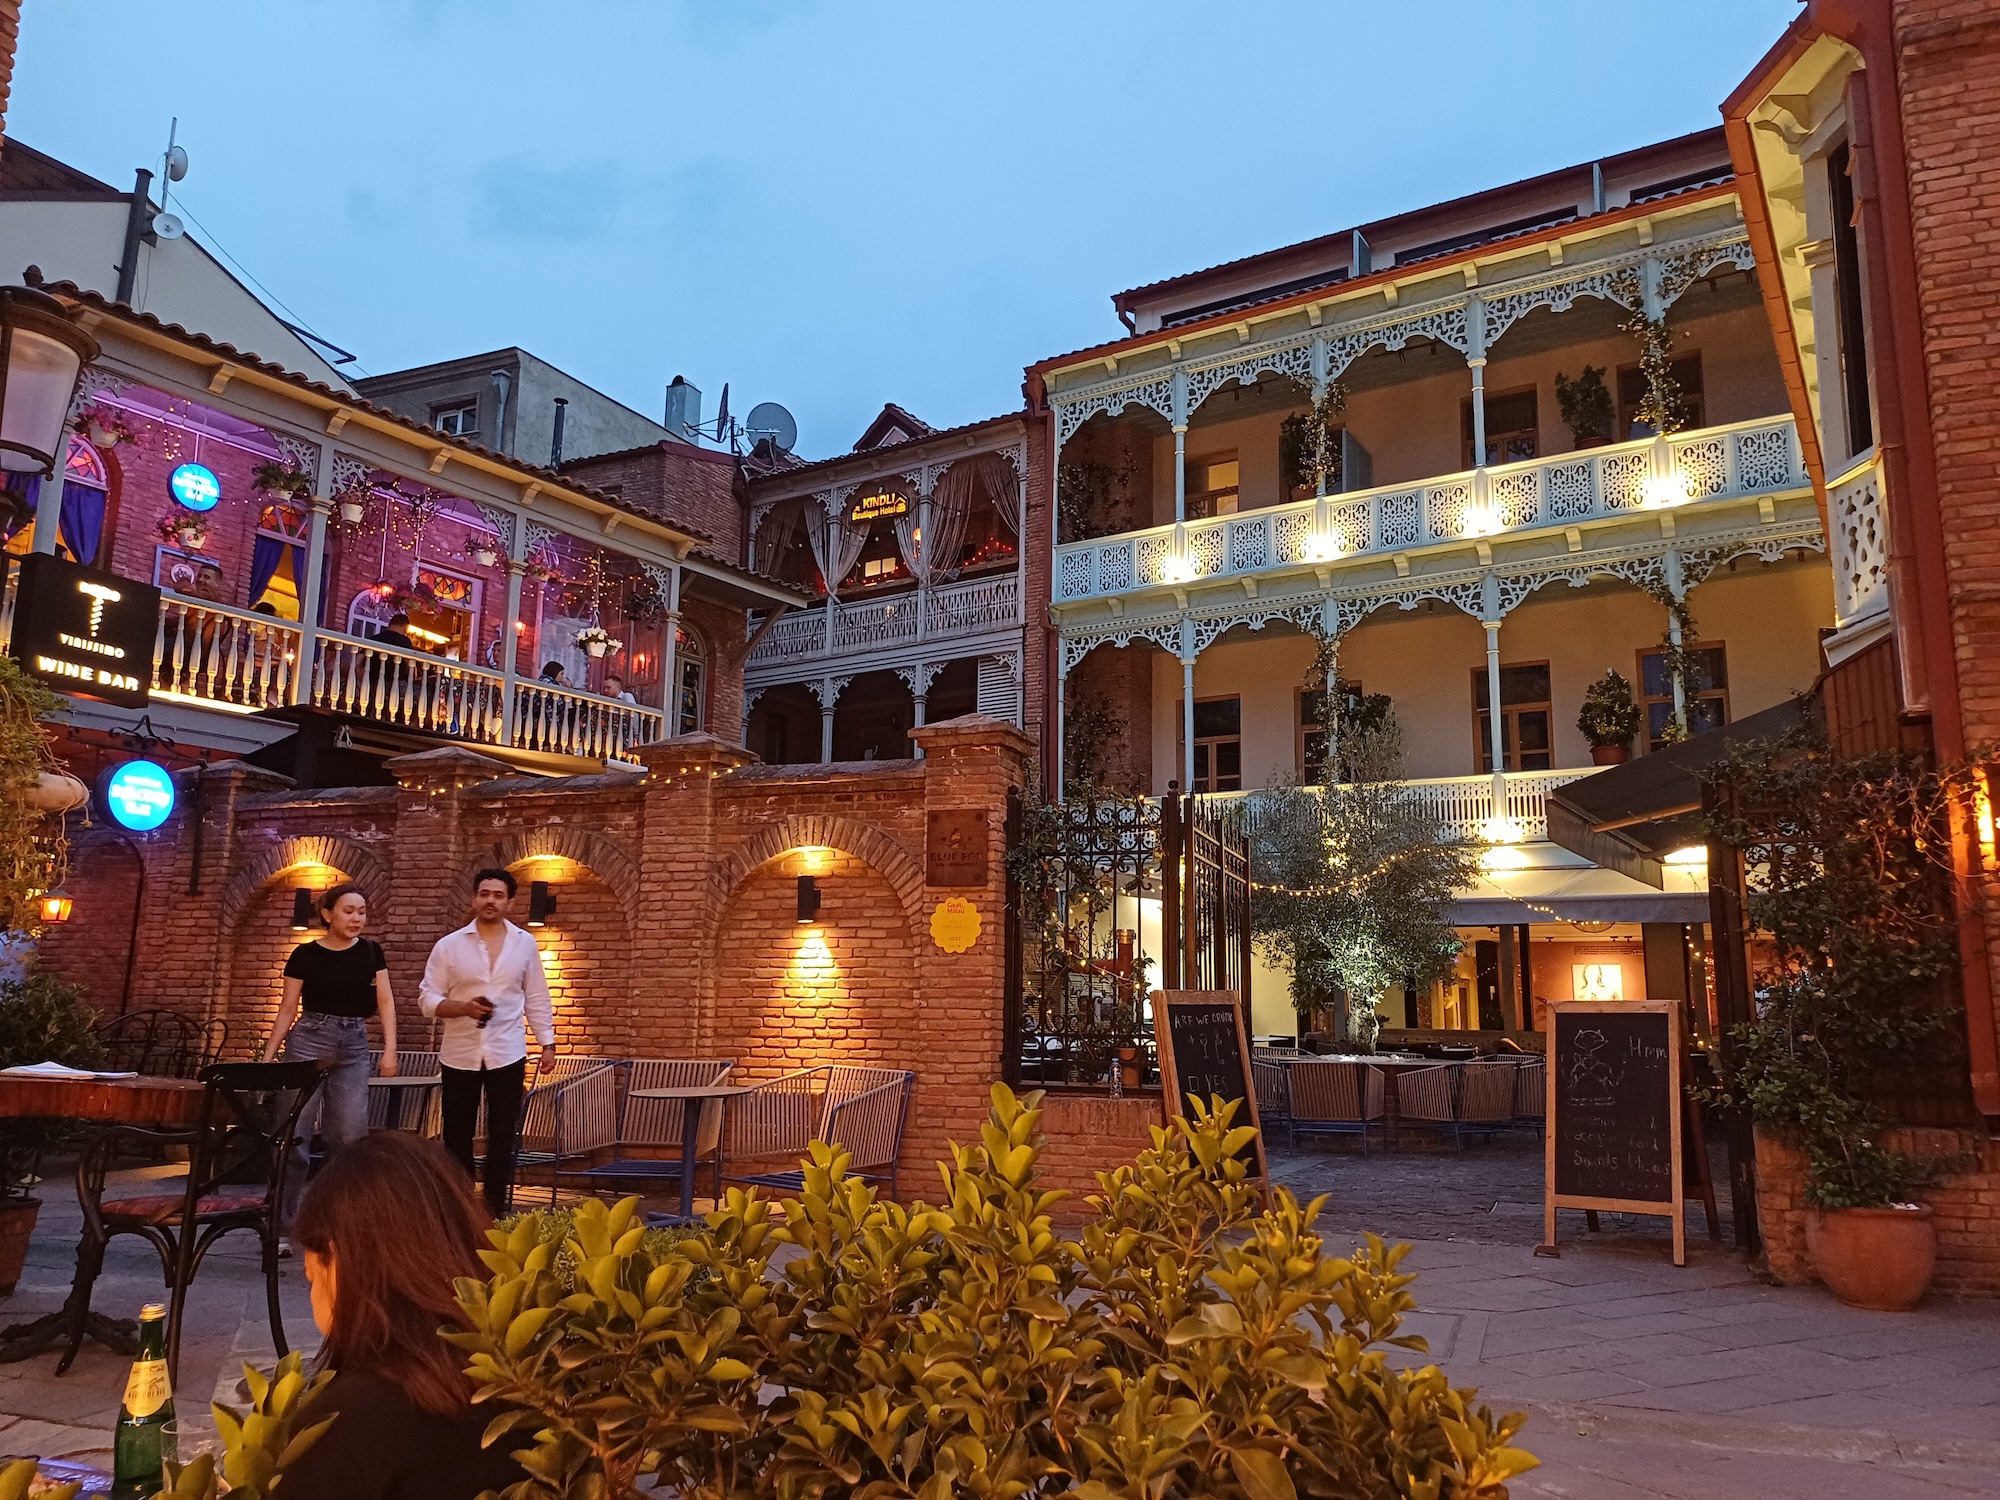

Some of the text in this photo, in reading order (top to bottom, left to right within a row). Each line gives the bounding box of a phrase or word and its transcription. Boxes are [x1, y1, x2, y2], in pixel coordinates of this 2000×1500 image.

[862, 493, 896, 509] KINDLI
[851, 504, 896, 521] Boutique Hotel
[38, 655, 139, 692] WINE BAR
[1174, 1014, 1194, 1029] ARE
[1195, 1014, 1209, 1025] WE
[1204, 1072, 1229, 1095] YES
